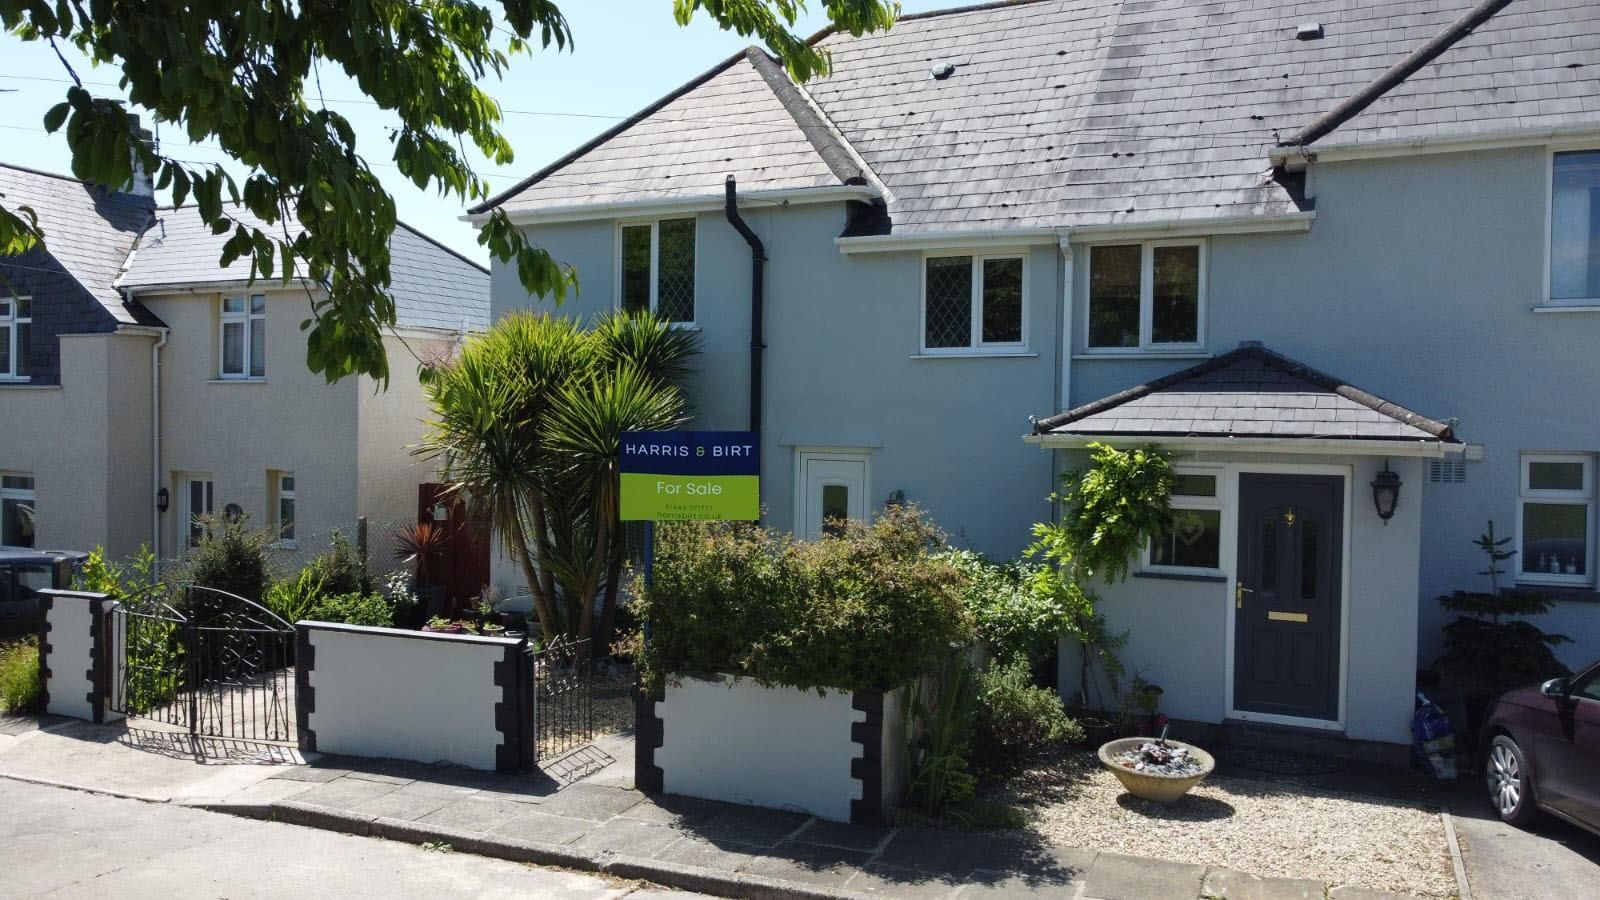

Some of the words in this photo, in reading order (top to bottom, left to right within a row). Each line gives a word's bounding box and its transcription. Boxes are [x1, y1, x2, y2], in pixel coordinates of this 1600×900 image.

[625, 443, 689, 457] HARRIS
[696, 446, 705, 457] &
[713, 445, 752, 457] BIRT
[656, 481, 682, 494] For
[686, 482, 722, 496] Sale
